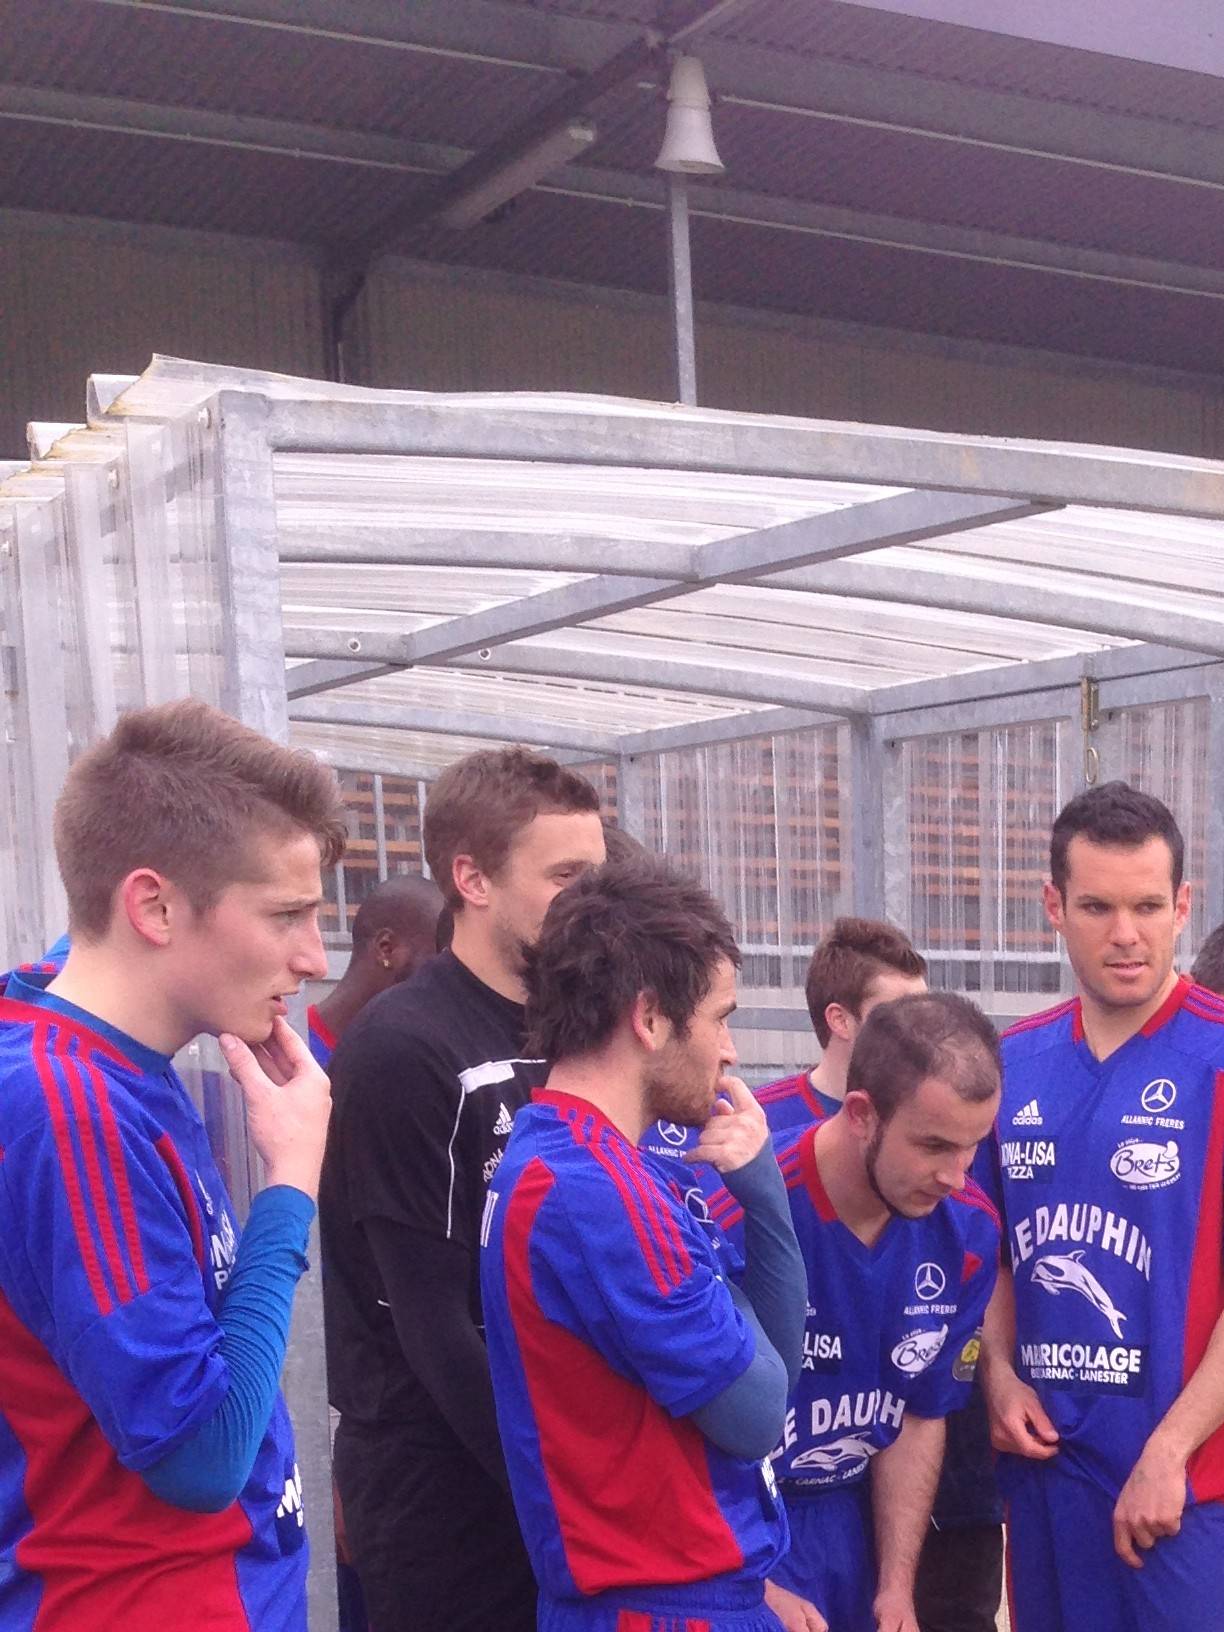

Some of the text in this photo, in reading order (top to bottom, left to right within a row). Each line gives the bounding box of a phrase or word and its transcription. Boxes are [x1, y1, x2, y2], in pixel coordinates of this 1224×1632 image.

[1012, 1116, 1043, 1126] adidas
[1010, 1203, 1152, 1283] LE DAUPHIN
[1080, 1369, 1128, 1384] LANESTER
